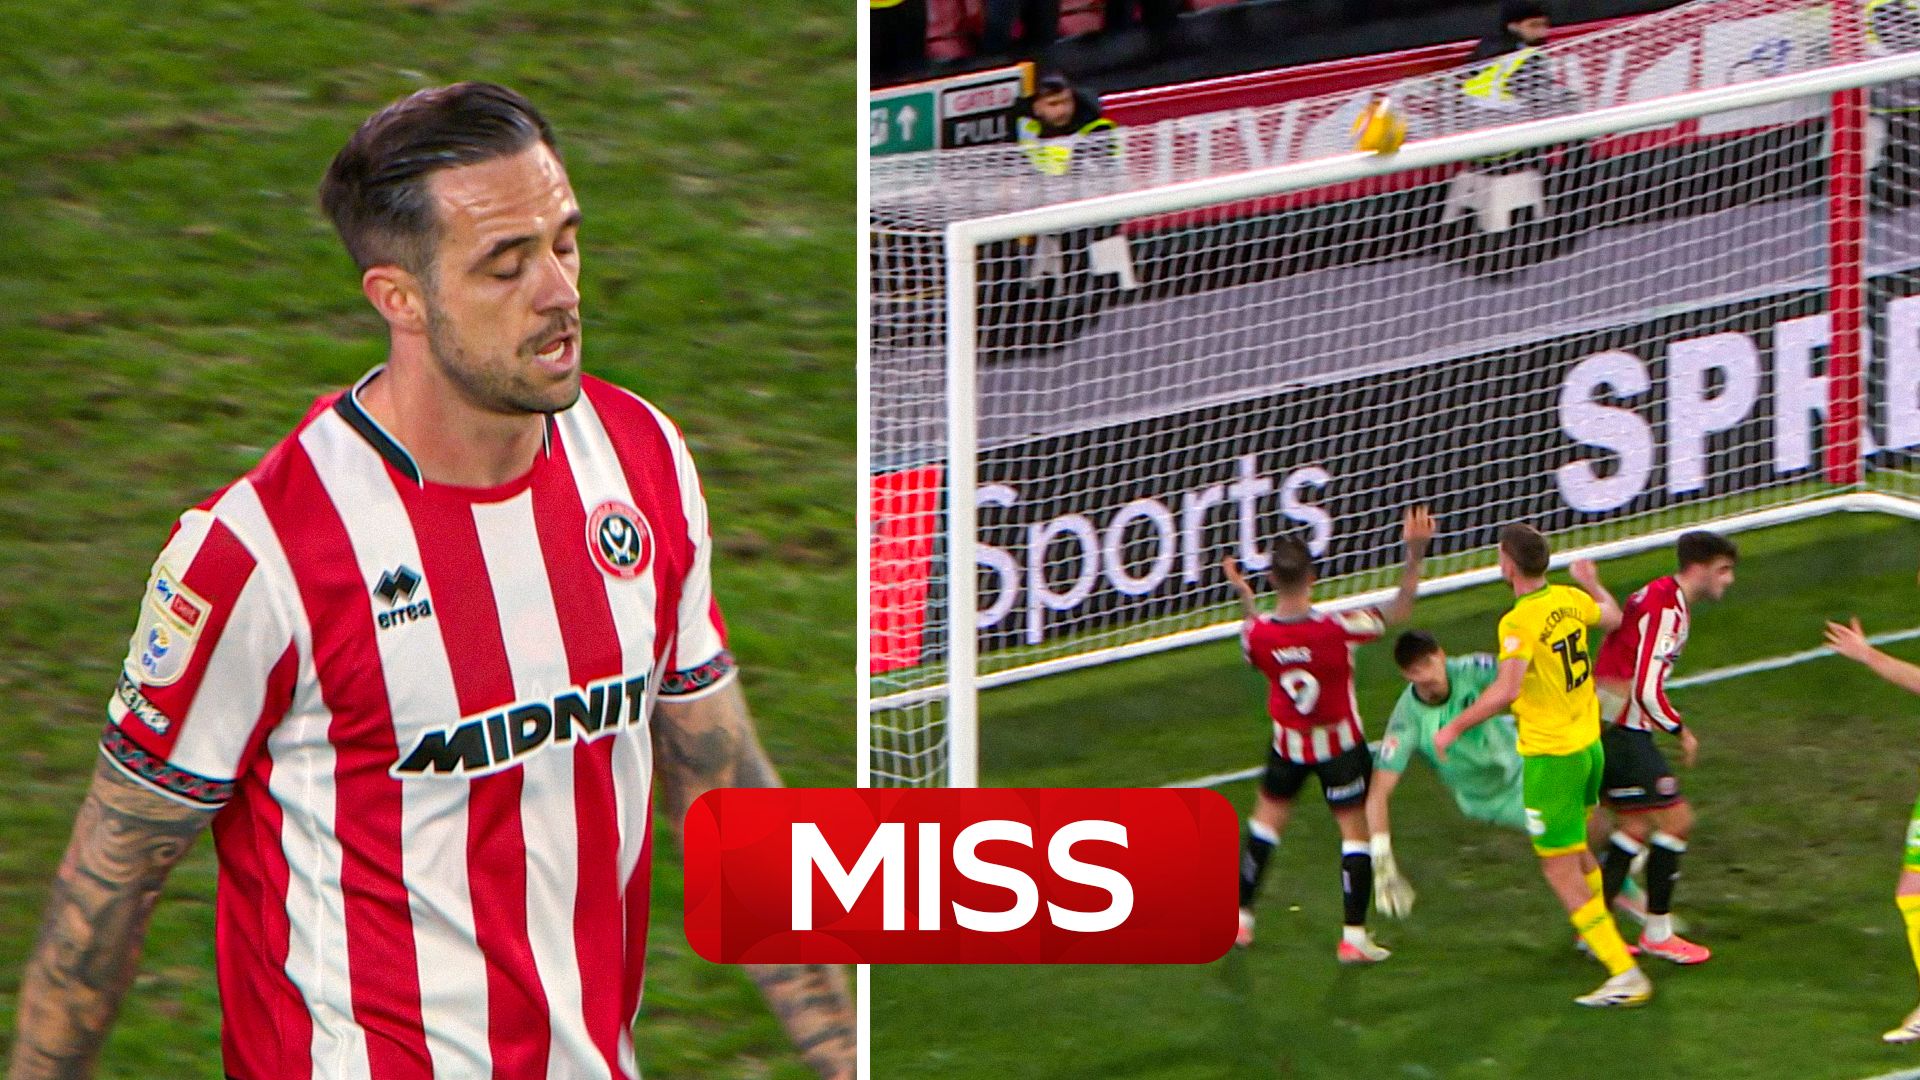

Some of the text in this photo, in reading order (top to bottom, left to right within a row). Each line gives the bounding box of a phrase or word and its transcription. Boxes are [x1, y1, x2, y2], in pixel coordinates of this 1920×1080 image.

[953, 114, 1008, 146] PULL
[976, 454, 1333, 645] Sports
[1280, 668, 1320, 715] 9
[1552, 629, 1591, 693] 15
[397, 672, 651, 773] MIDNIT
